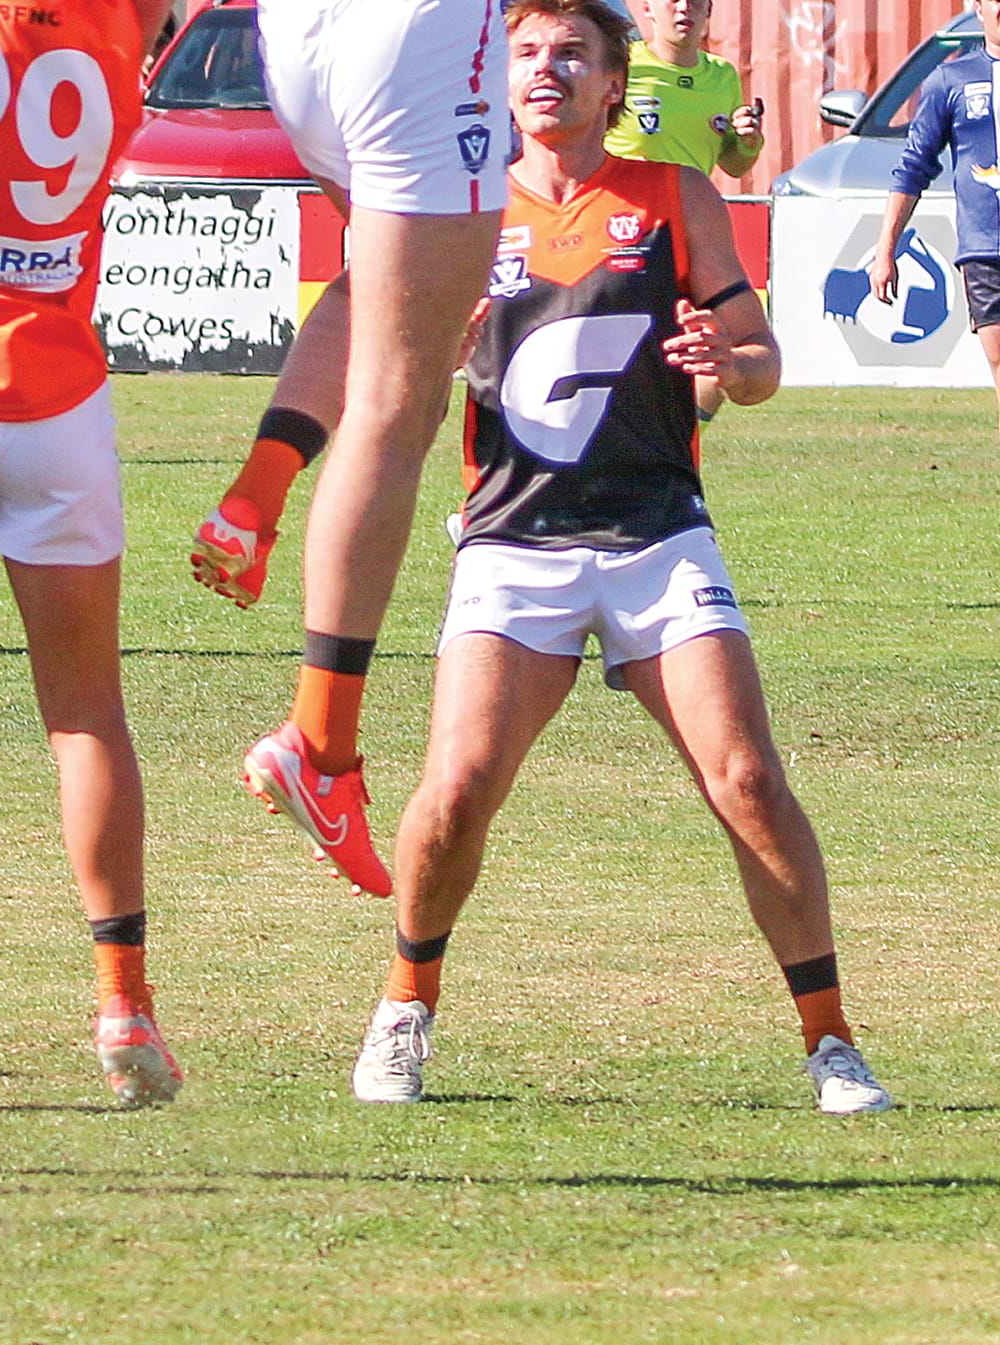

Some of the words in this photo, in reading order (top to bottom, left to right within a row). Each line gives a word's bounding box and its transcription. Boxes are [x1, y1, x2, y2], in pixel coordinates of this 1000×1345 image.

[102, 204, 276, 244] onthaggi
[104, 261, 272, 295] eongatha
[117, 307, 235, 340] Cowes
